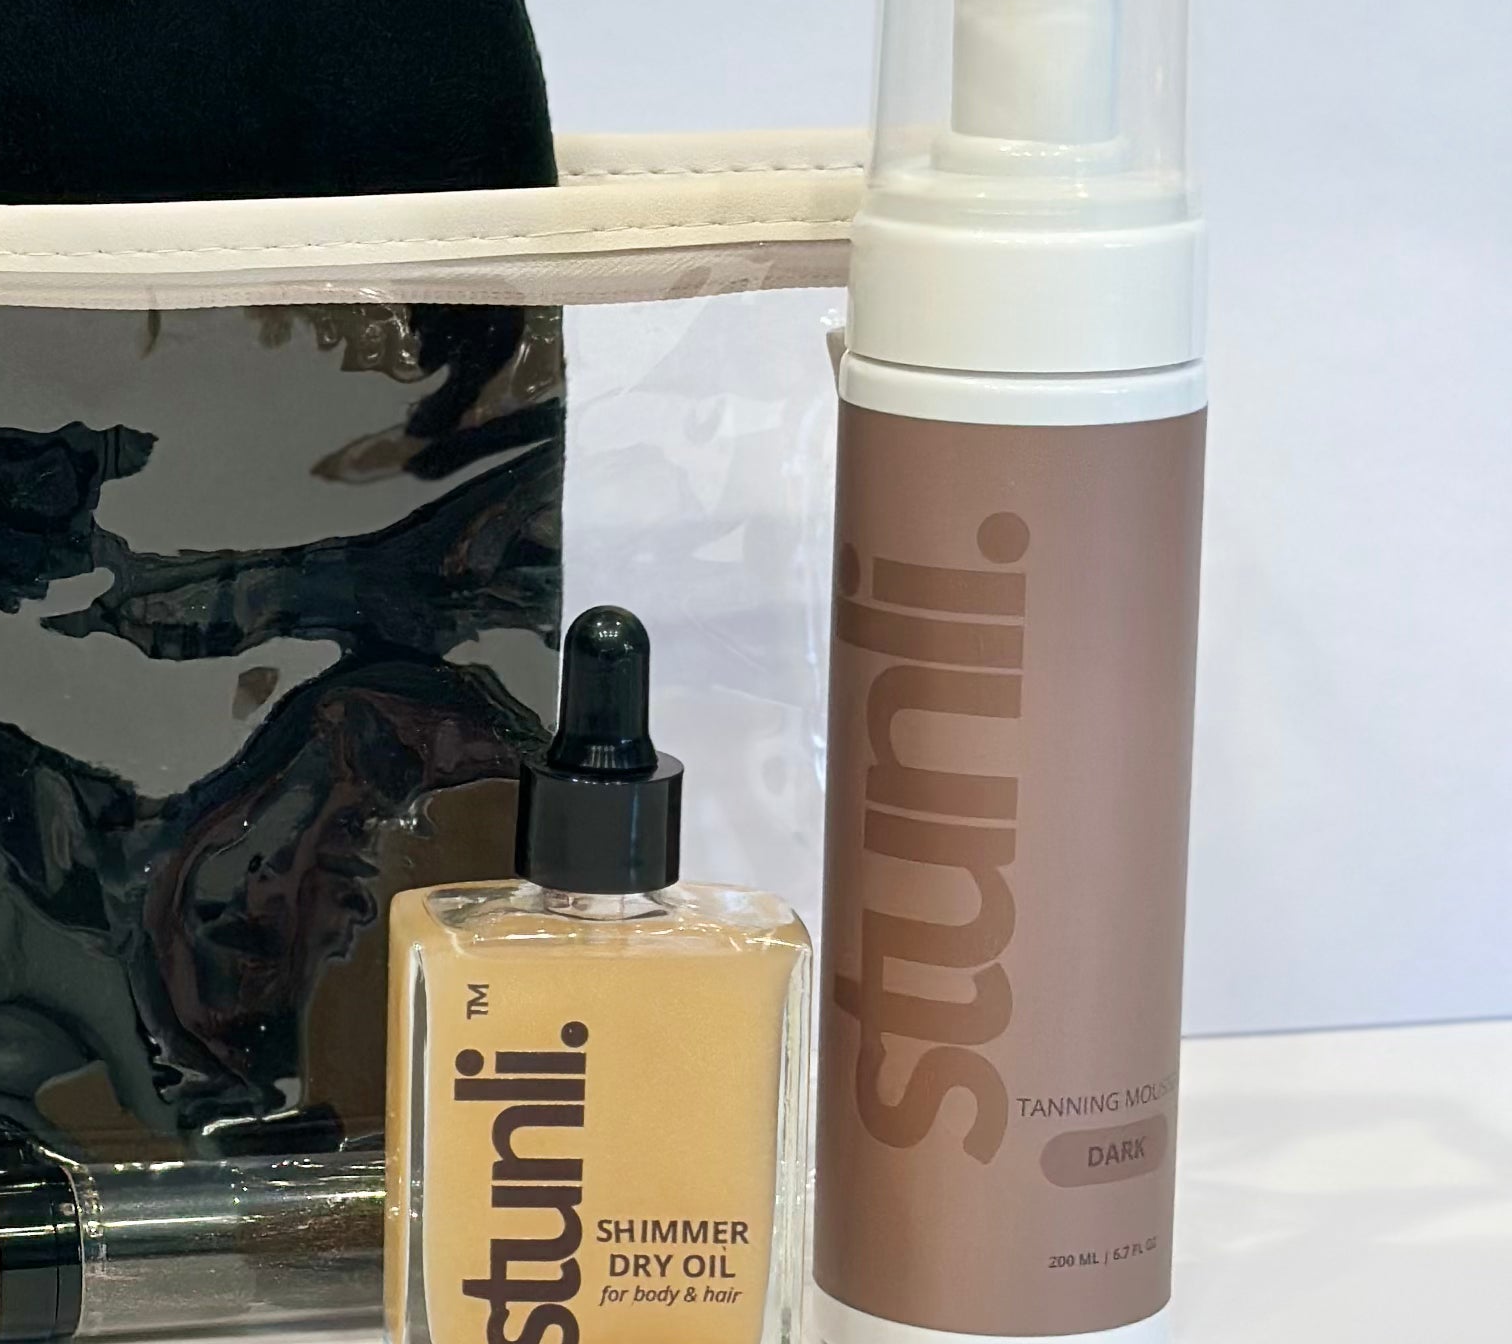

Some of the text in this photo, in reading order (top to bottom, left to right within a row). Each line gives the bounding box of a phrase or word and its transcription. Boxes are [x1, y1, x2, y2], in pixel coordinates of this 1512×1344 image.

[1016, 1092, 1119, 1118] TANNING
[1088, 1136, 1148, 1167] DARK
[596, 1219, 750, 1245] SHIMMER
[609, 1253, 736, 1279] DRY OIL
[1049, 1255, 1075, 1269] 200
[1079, 1253, 1099, 1266] ML
[598, 1285, 743, 1306] for body & hair
